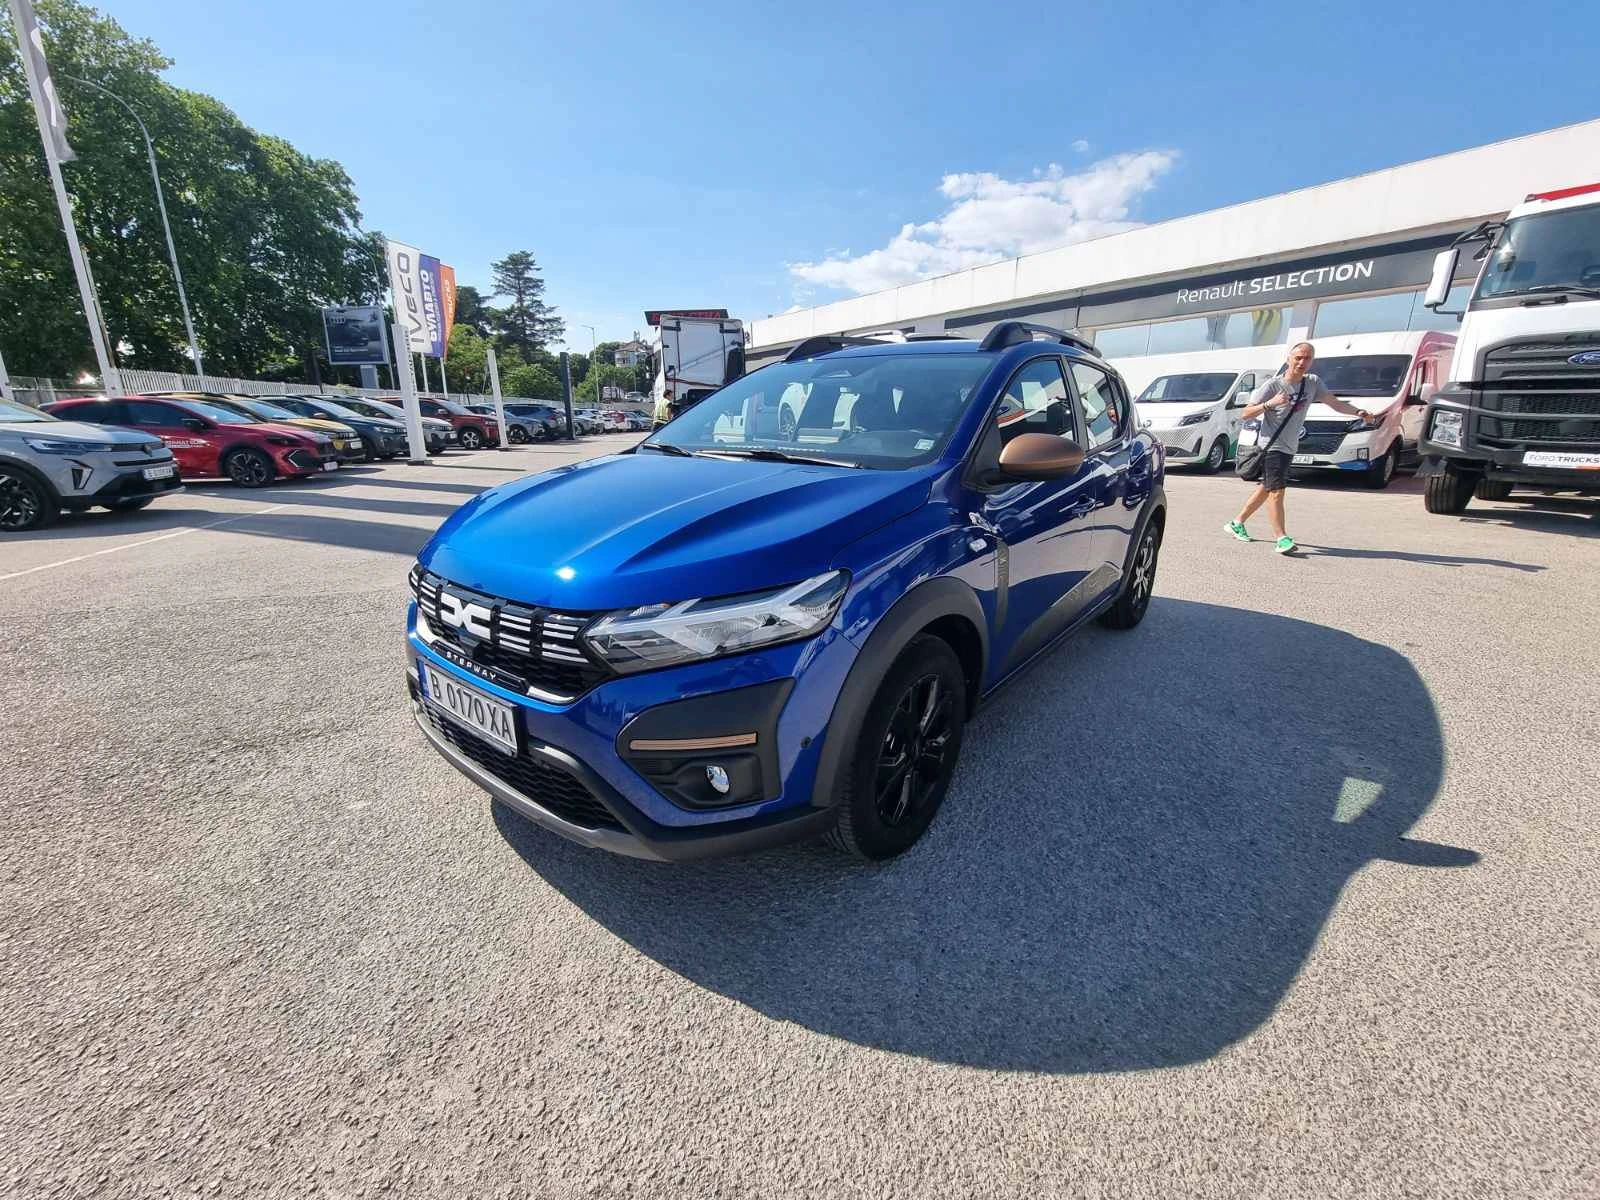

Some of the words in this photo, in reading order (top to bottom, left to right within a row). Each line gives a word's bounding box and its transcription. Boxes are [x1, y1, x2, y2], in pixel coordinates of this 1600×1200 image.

[397, 252, 425, 343] IVECO
[1176, 280, 1246, 304] Renault
[1249, 261, 1374, 294] SELECTION
[1529, 454, 1556, 462] FORD
[1558, 455, 1600, 464] TRUCKS
[446, 650, 497, 681] STEPWAY
[430, 669, 442, 700] B
